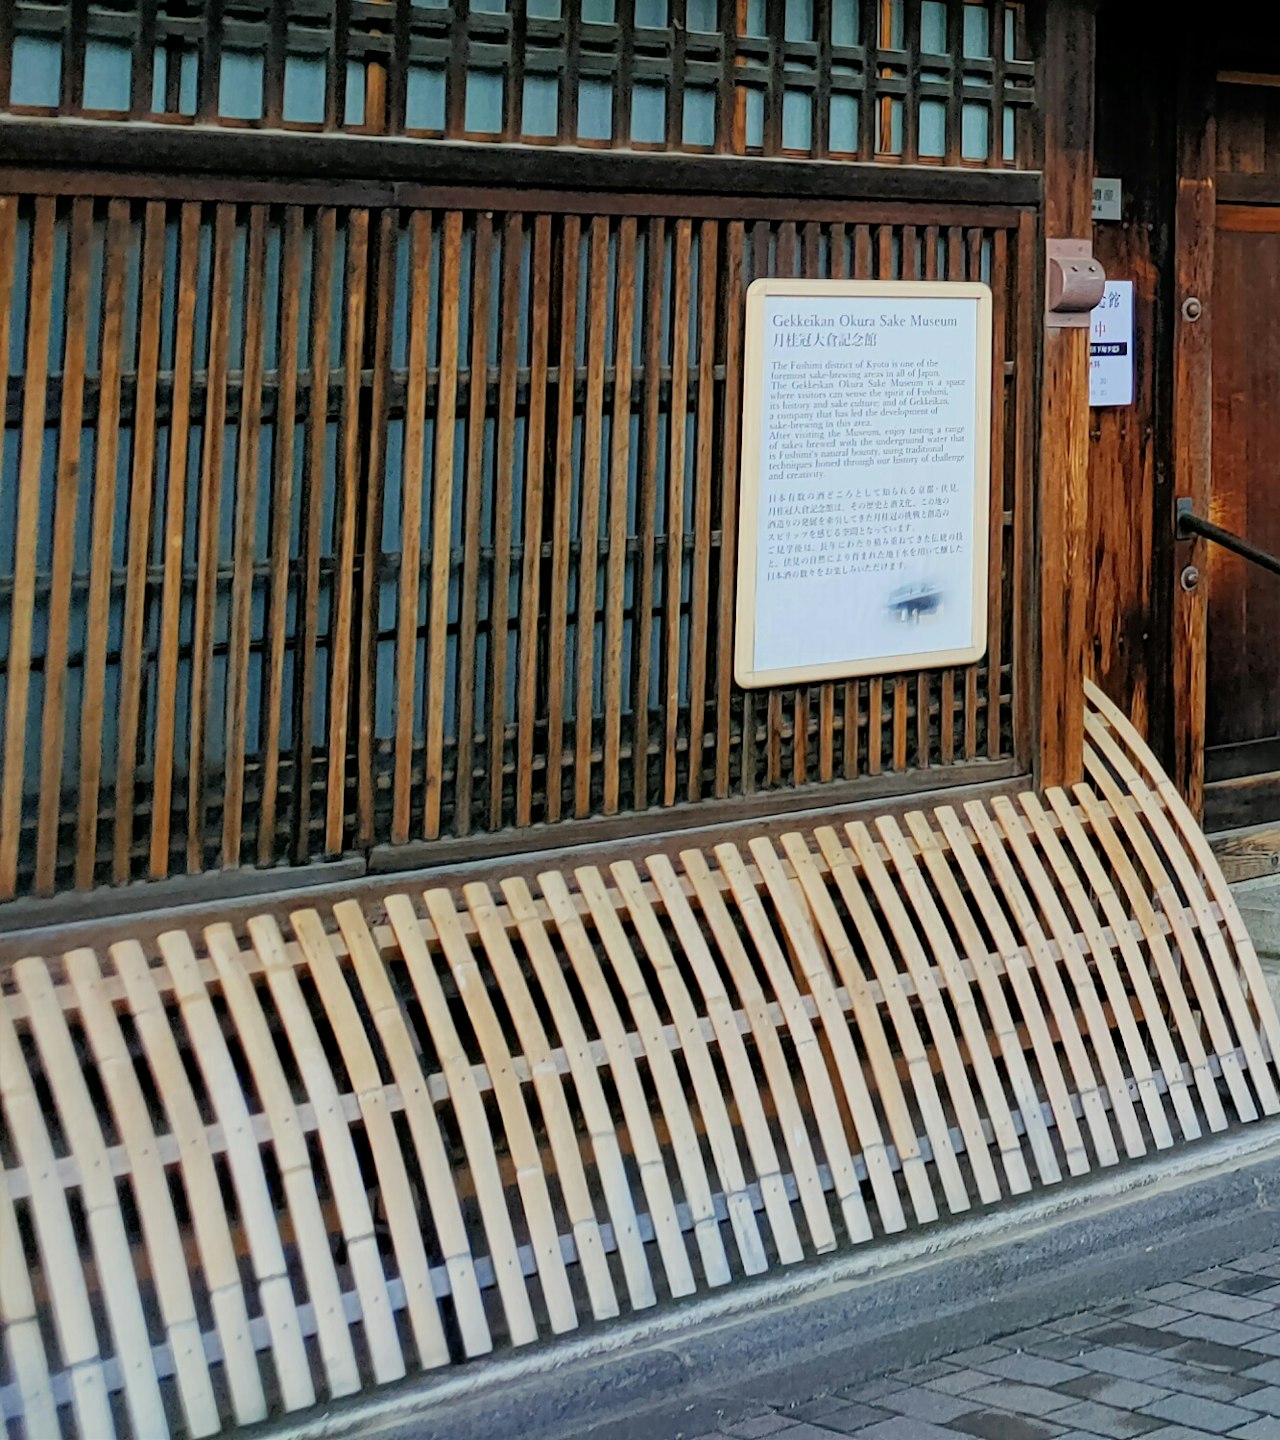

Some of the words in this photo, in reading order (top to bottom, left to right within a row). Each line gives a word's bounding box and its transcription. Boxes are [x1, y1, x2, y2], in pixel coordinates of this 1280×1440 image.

[773, 314, 834, 327] Gekkeikan
[839, 314, 875, 327] Okura
[880, 314, 906, 327] Sake
[910, 314, 957, 327] Museum
[1095, 321, 1106, 337] 中
[774, 332, 877, 347] 月桂冠大倉記念館
[771, 361, 787, 370] The
[790, 361, 823, 370] Fushimi
[825, 361, 852, 369] district
[855, 360, 864, 368] of
[866, 360, 889, 370] Kyoto
[892, 360, 898, 368] is
[916, 359, 925, 367] of
[927, 359, 939, 367] the
[771, 371, 806, 380] foremost
[809, 370, 861, 379] sake-brewing
[896, 369, 905, 377] all
[907, 368, 916, 377] of
[771, 381, 787, 390] The
[792, 380, 833, 389] Gekkeikan
[839, 379, 863, 388] Okura
[868, 379, 886, 387] Sake
[890, 378, 923, 387] Museum
[770, 391, 794, 399] where
[869, 388, 882, 397] the
[884, 388, 904, 398] spirit
[906, 388, 914, 396] of
[782, 401, 809, 410] history
[813, 400, 828, 408] and
[830, 399, 848, 408] sake
[882, 398, 896, 406] and
[899, 398, 907, 406] of
[777, 412, 813, 421] company
[816, 410, 832, 418] that
[835, 409, 848, 417] has
[851, 408, 863, 417] led
[865, 408, 878, 416] the
[880, 407, 928, 418] development
[930, 406, 938, 415] of
[769, 421, 823, 430] sake-brewing
[825, 420, 834, 428] in
[837, 419, 851, 427] this
[769, 431, 790, 440] After
[795, 431, 824, 439] visiting
[828, 429, 841, 438] the
[909, 427, 934, 435] tasting
[769, 441, 777, 450] of
[782, 440, 803, 449] sakes
[806, 438, 836, 448] brewed
[839, 438, 857, 447] with
[860, 438, 873, 446] the
[876, 435, 924, 446] underground
[950, 434, 965, 442] that
[820, 448, 848, 457] natural
[905, 444, 944, 454] traditional
[769, 460, 812, 471] techniques
[815, 458, 840, 467] honed
[843, 457, 874, 467] through
[893, 455, 918, 465] history
[921, 453, 929, 462] of
[931, 453, 965, 463] challenge
[769, 470, 784, 480] and
